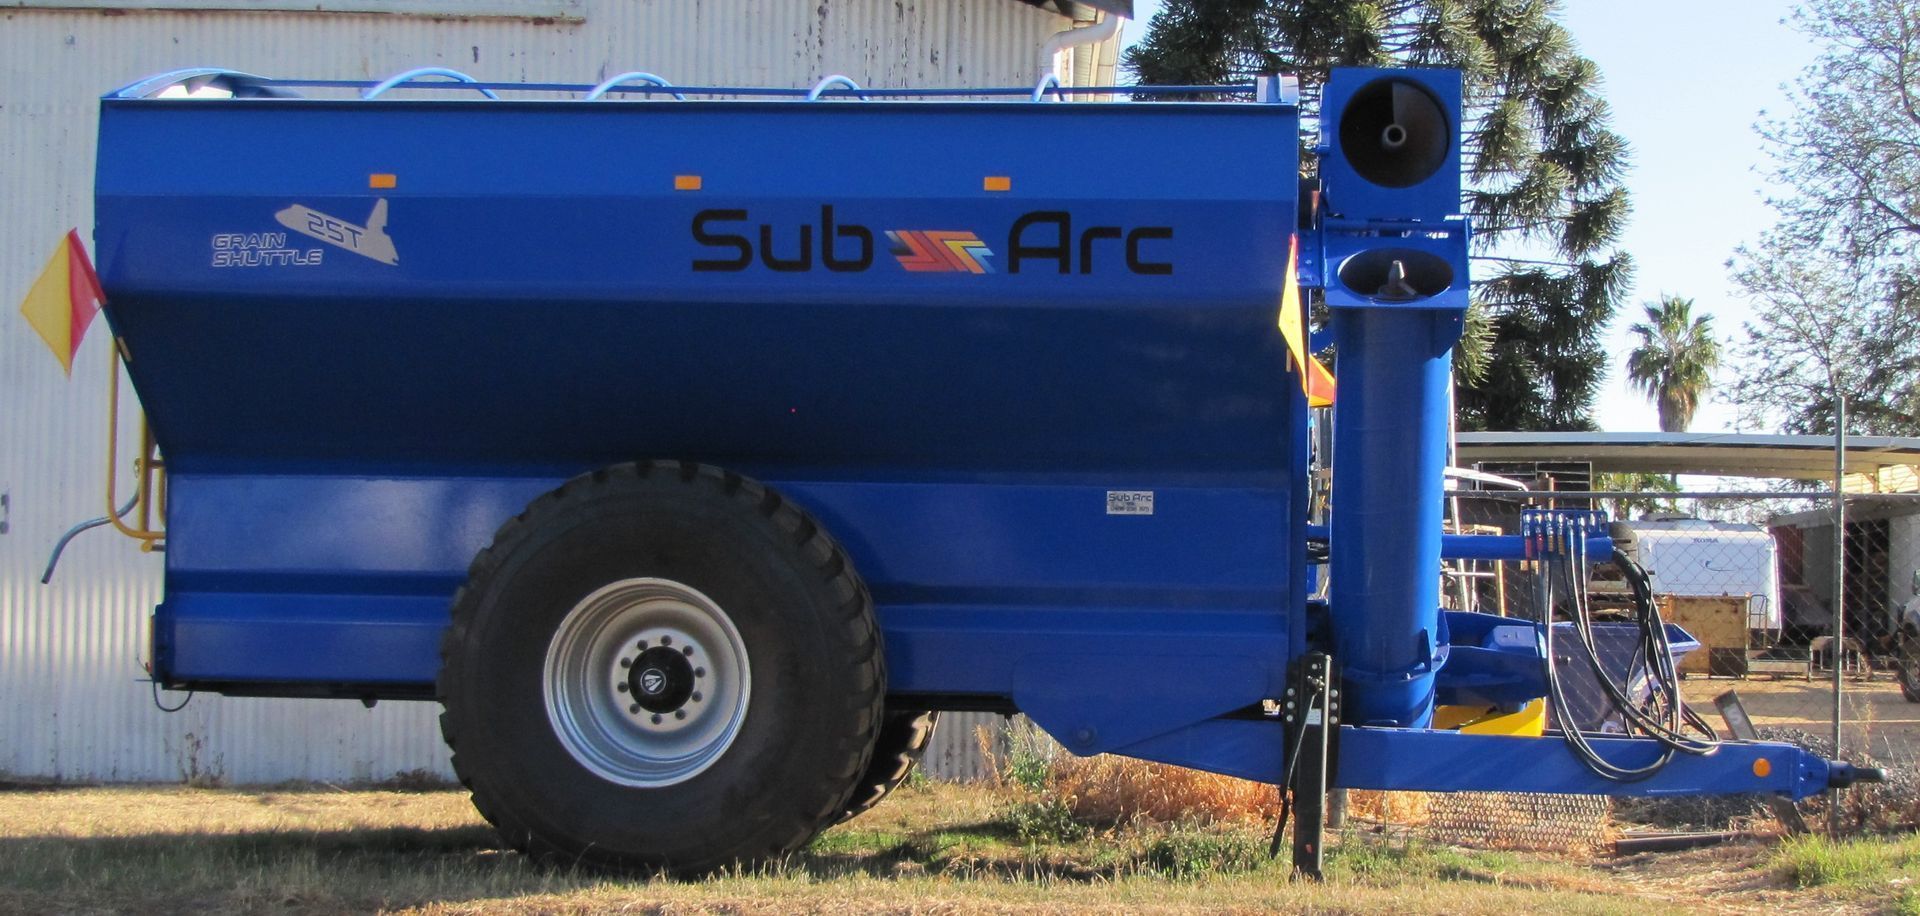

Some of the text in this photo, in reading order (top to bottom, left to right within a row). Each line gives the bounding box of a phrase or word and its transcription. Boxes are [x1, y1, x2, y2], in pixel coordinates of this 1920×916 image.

[306, 212, 363, 249] 25T
[691, 204, 1173, 274] Sub Arc
[212, 232, 286, 249] GRAIN
[212, 249, 324, 267] SHUTTLE
[1109, 493, 1152, 502] Sub Arc
